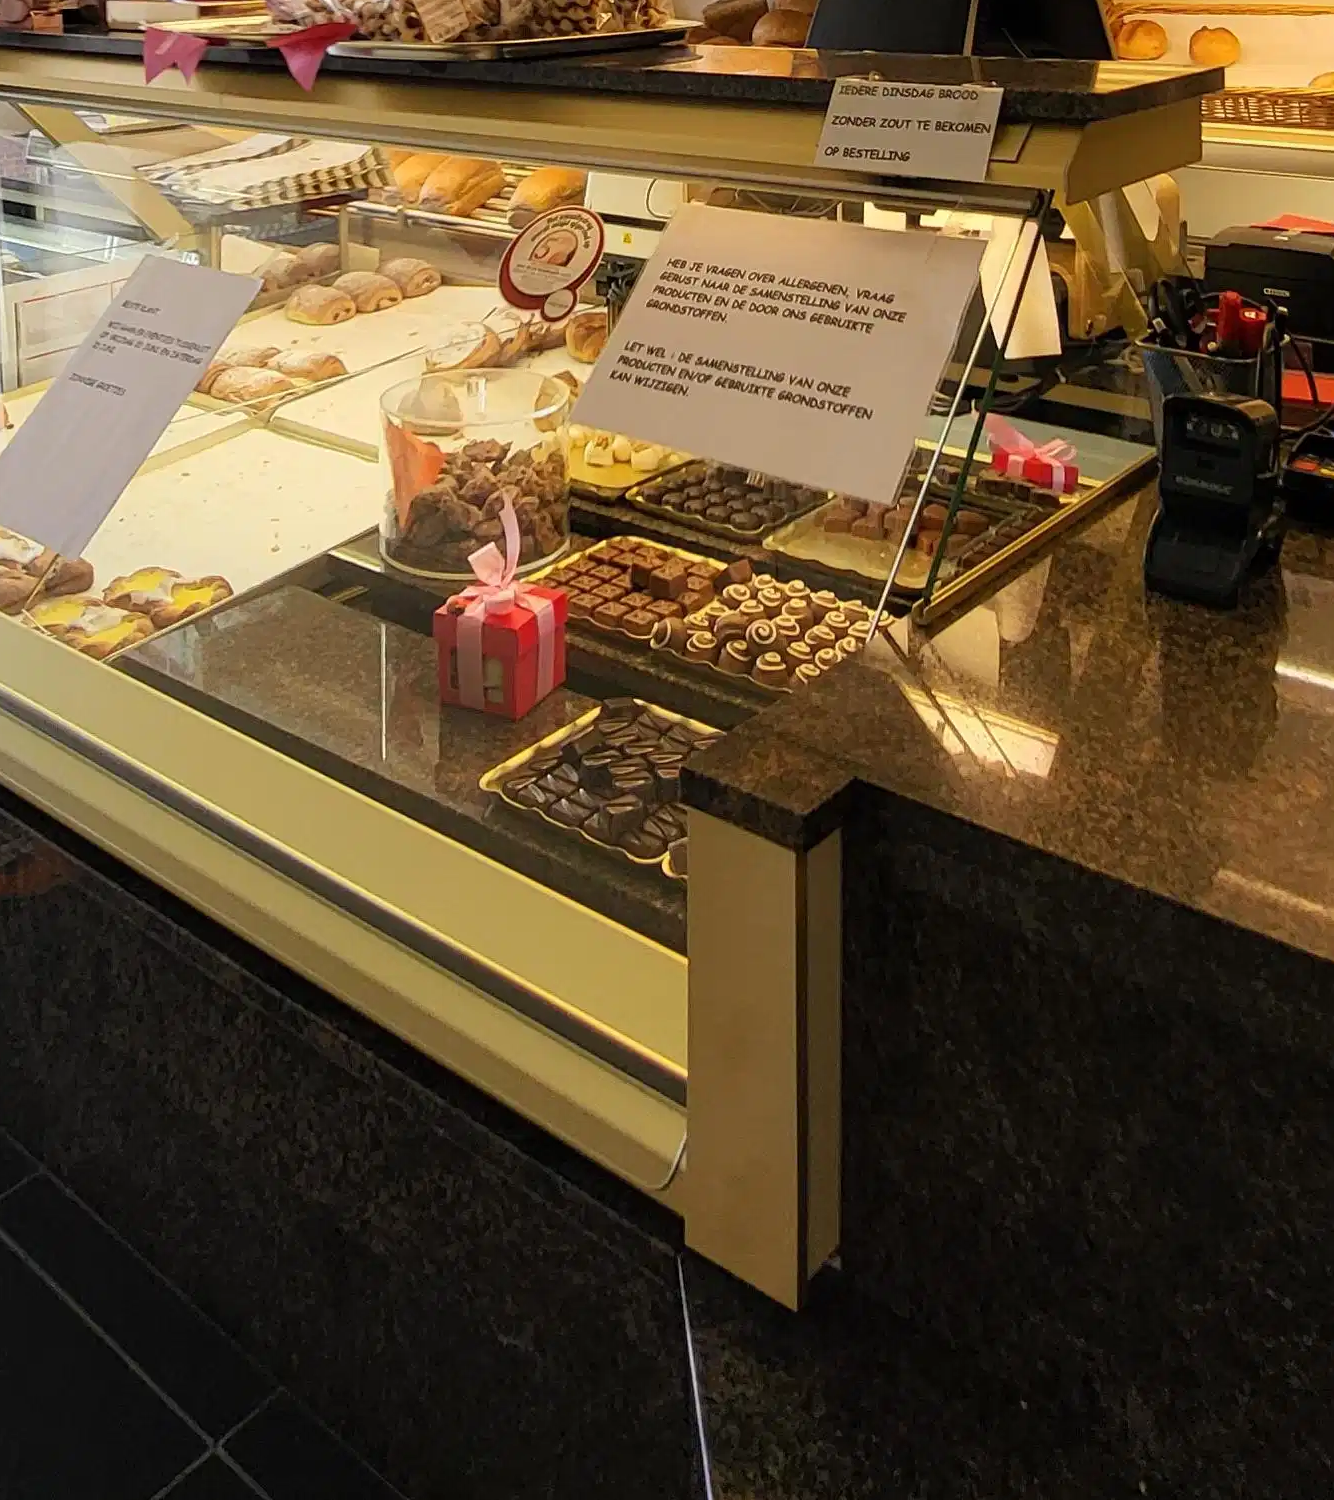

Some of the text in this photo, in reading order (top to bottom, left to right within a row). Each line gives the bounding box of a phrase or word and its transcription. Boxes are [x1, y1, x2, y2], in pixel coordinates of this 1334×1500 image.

[839, 84, 979, 100] IEDERE DINSDAG BROOD
[831, 115, 992, 134] ZONDER ZOUT TE BEKOMEN
[824, 146, 911, 162] OP BESTELLING
[659, 271, 907, 323] GERUST NAAR DE SAMENSTELLING VAN ONZE
[667, 258, 895, 304] HEB JE VRAGEN OVER ALLERGENEN, VRAAG
[646, 299, 728, 323] GRONDSTOFFEN.
[653, 285, 874, 334] PRODUCTEN EN DE DOOR ONS GEBRUIKTE
[609, 370, 689, 397] KAN WIJZIGEN.
[617, 354, 873, 420] PRODUCTEN EN/OF GEBRUIKTE GRONDSTOFFEN
[624, 341, 645, 353] LET
[647, 345, 666, 358] WEL
[677, 352, 694, 364] DE
[695, 356, 785, 383] SAMENSTELLING
[789, 374, 814, 389] VAN
[816, 381, 851, 398] ONZE
